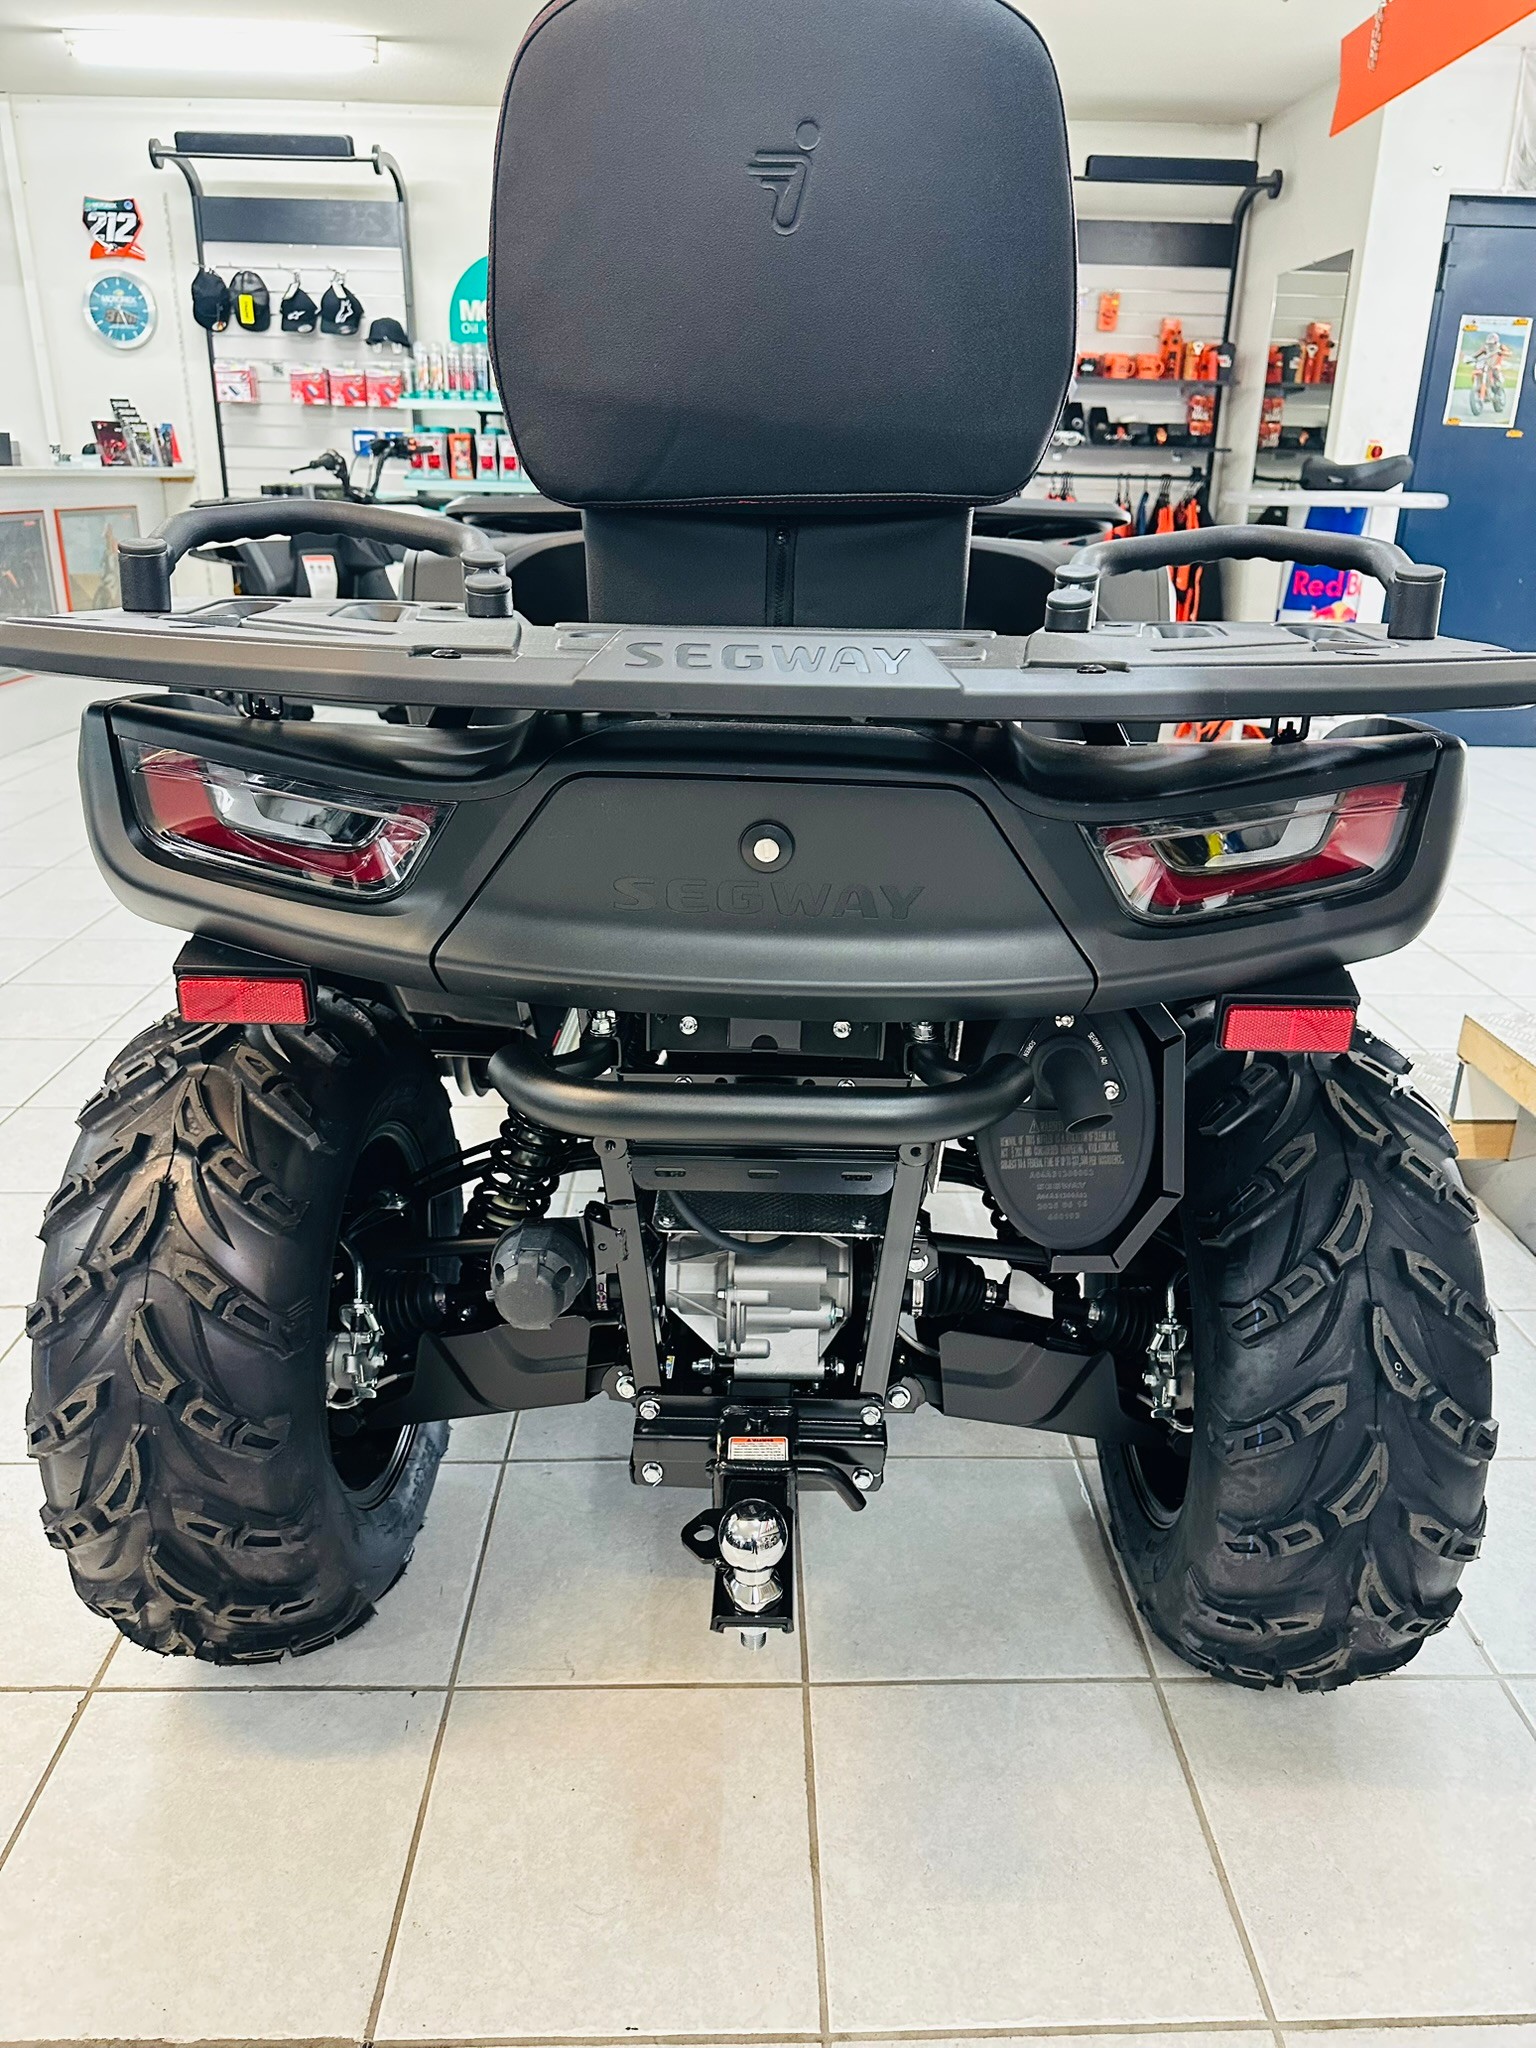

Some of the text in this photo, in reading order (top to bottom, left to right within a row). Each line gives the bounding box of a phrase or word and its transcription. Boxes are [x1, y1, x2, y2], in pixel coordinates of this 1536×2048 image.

[87, 211, 137, 242] 212
[1293, 570, 1345, 597] Red
[625, 642, 911, 674] SEGWAY
[613, 876, 925, 920] SEGWAY
